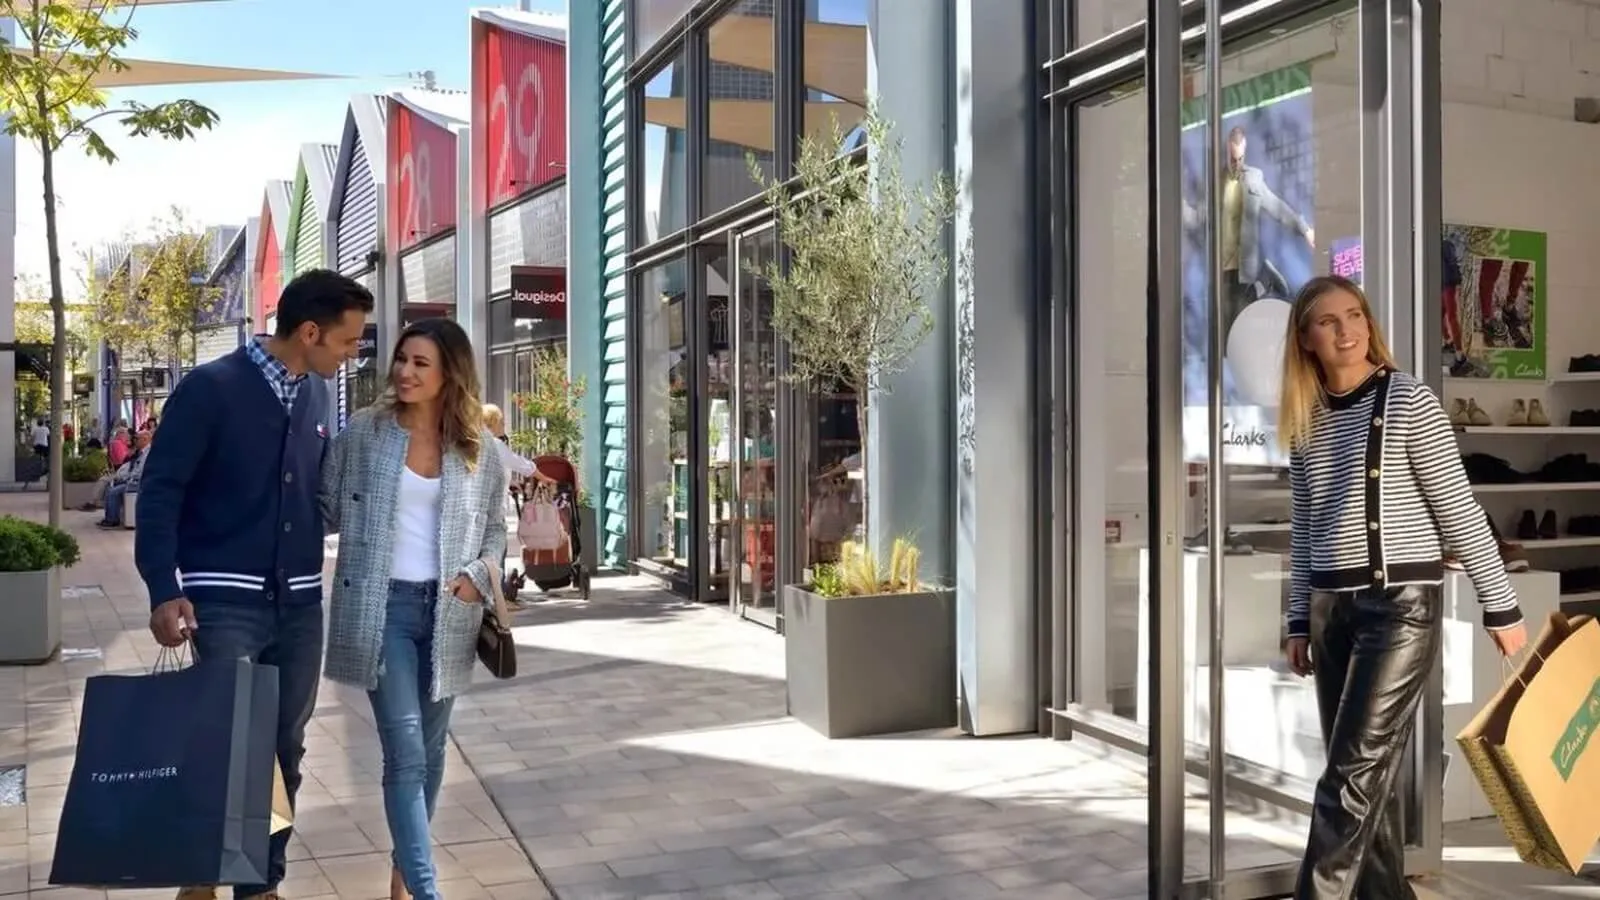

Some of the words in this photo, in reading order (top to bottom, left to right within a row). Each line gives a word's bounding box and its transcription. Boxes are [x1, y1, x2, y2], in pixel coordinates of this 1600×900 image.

[490, 62, 545, 204] 29
[1514, 363, 1544, 377] Clarks
[138, 766, 178, 779] HILFIGER
